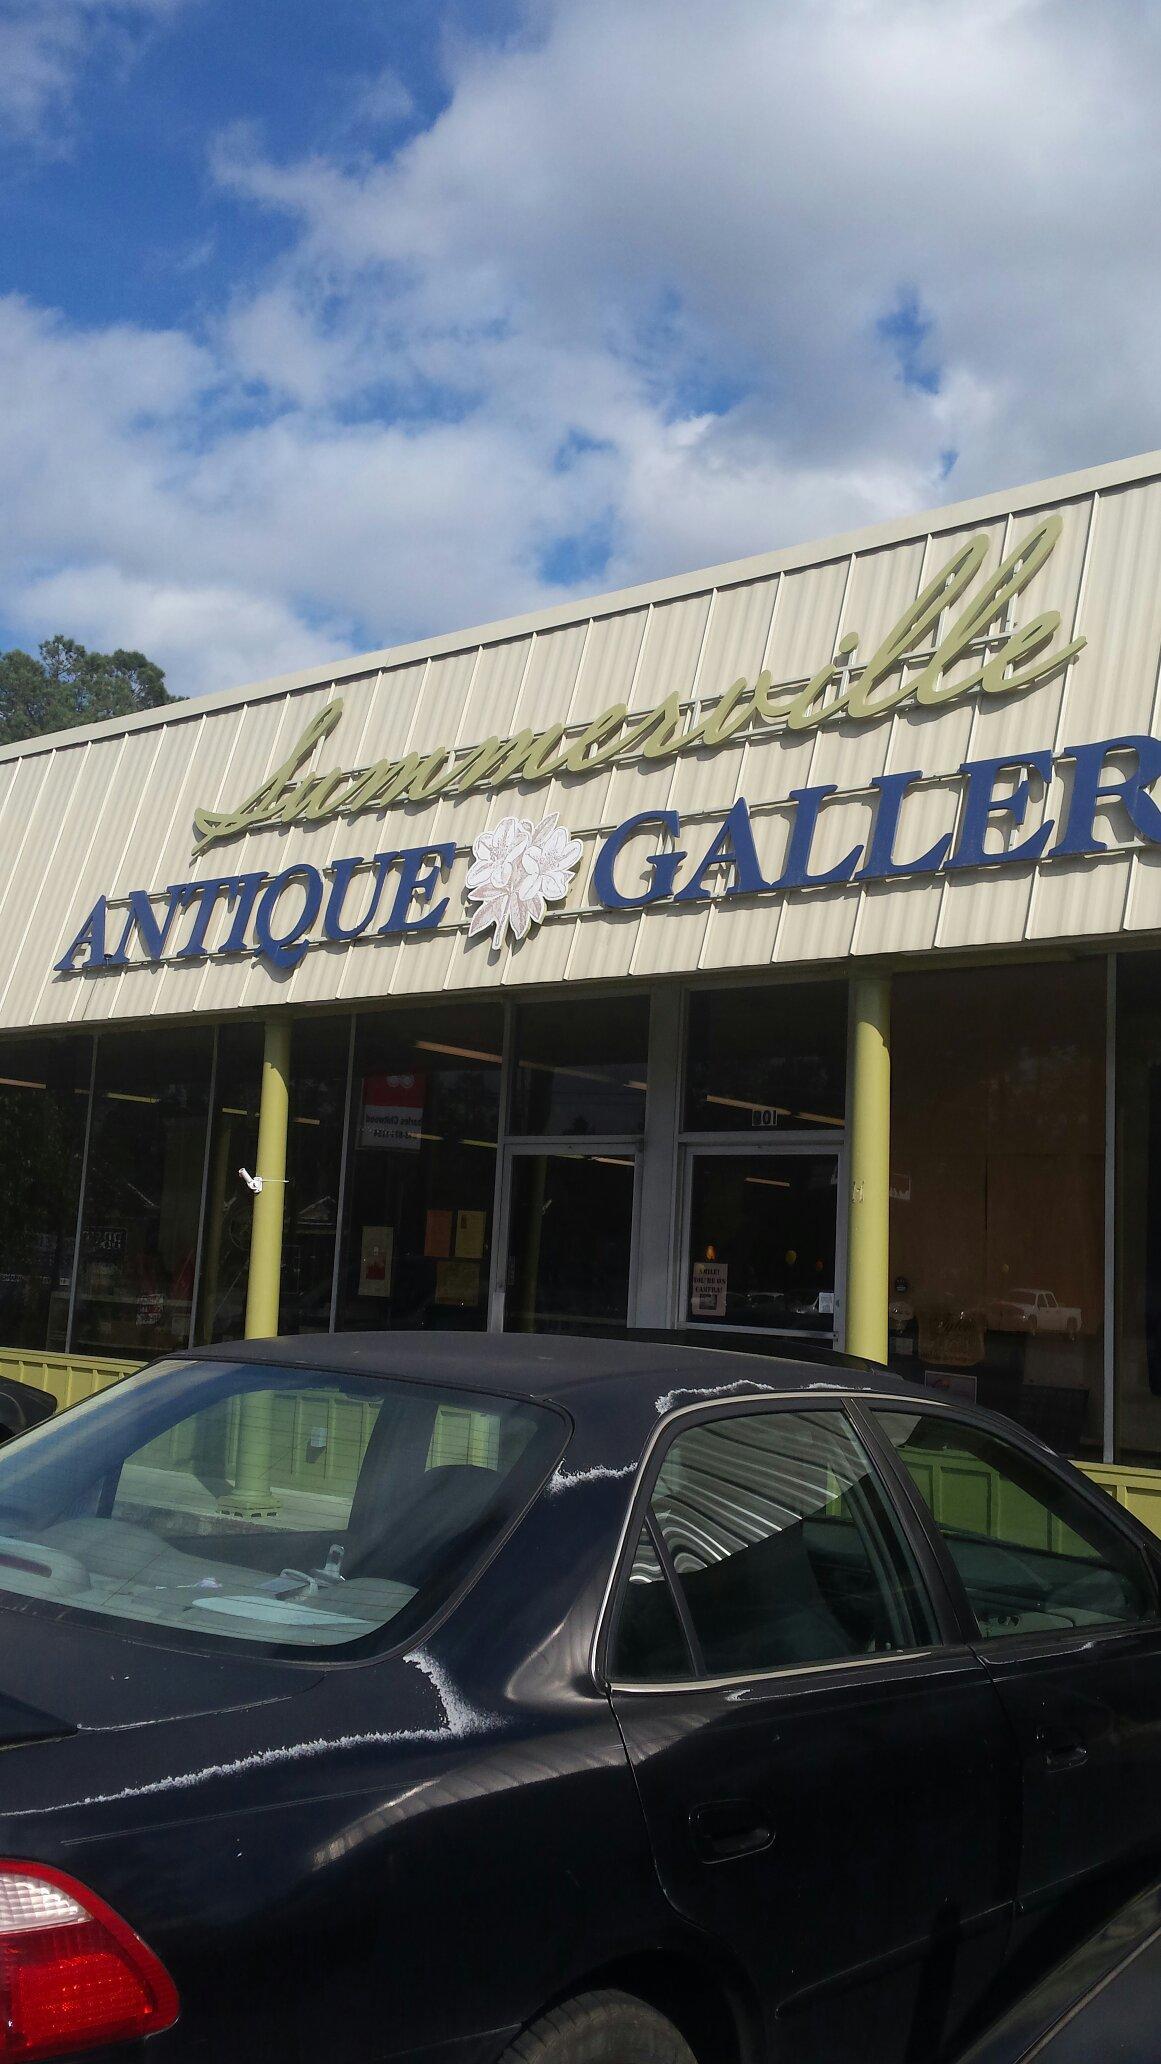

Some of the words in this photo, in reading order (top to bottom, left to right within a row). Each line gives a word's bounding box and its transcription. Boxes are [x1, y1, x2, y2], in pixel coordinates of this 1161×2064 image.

[192, 515, 1087, 857] Summerville
[53, 841, 457, 970] ANTIQUE
[590, 734, 1161, 909] GALLER
